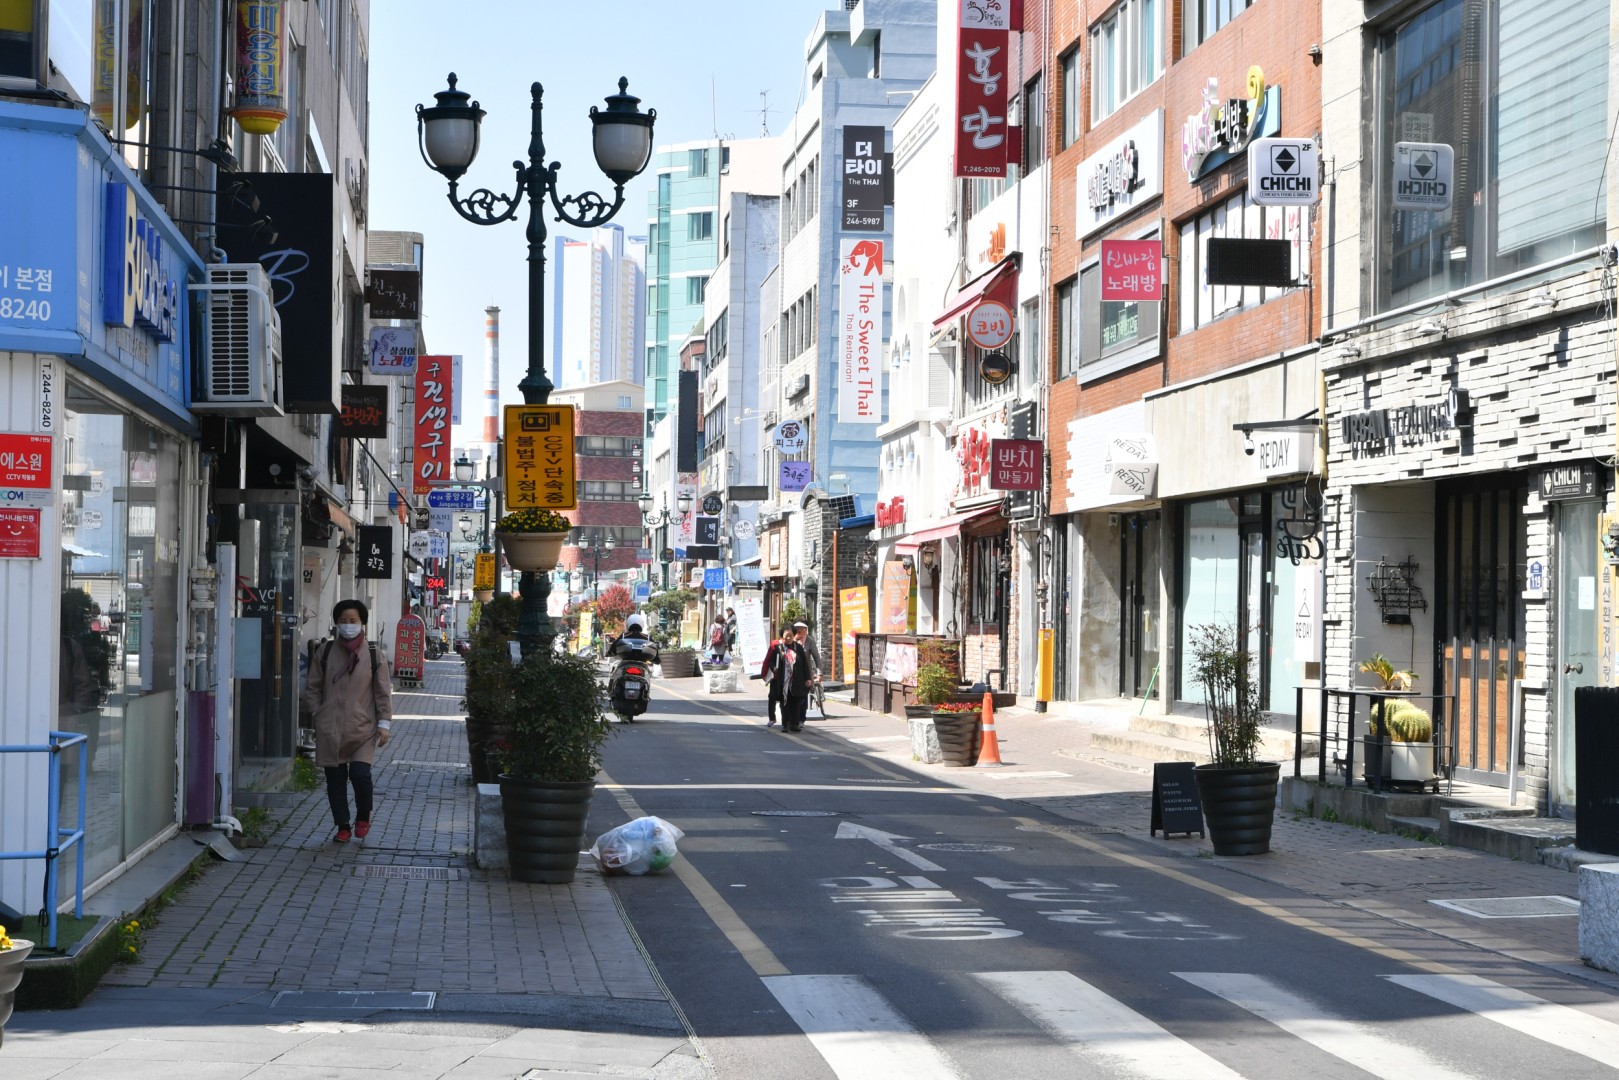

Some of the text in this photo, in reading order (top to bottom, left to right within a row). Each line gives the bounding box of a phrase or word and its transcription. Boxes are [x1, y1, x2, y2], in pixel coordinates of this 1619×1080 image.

[856, 141, 872, 157] 더
[846, 159, 882, 175] 타이
[1260, 176, 1311, 191] CHICHI
[847, 200, 858, 208] 3F
[846, 217, 880, 225] 246-5987
[1106, 248, 1156, 271] 신바람
[14, 267, 52, 292] 본점
[1107, 274, 1156, 292] 노래방
[846, 313, 854, 328] Thai
[975, 320, 1006, 336] 코빈
[858, 282, 875, 416] The Sweet Thai
[378, 355, 415, 367] 노래방
[42, 363, 52, 428] T.244-8240
[0, 452, 42, 471] 에스원
[1259, 438, 1290, 470] RE'DAY
[6, 473, 21, 481] CCTV
[515, 435, 537, 503] 불법주·정차
[544, 435, 564, 503] CCTV단속중
[998, 470, 1034, 484] 만들기
[1553, 466, 1581, 486] CHICHI
[1115, 468, 1144, 492] RE'DAY
[0, 490, 24, 501] COM
[445, 492, 473, 501] 중앙2길
[1603, 566, 1612, 683] 울산환경사랑
